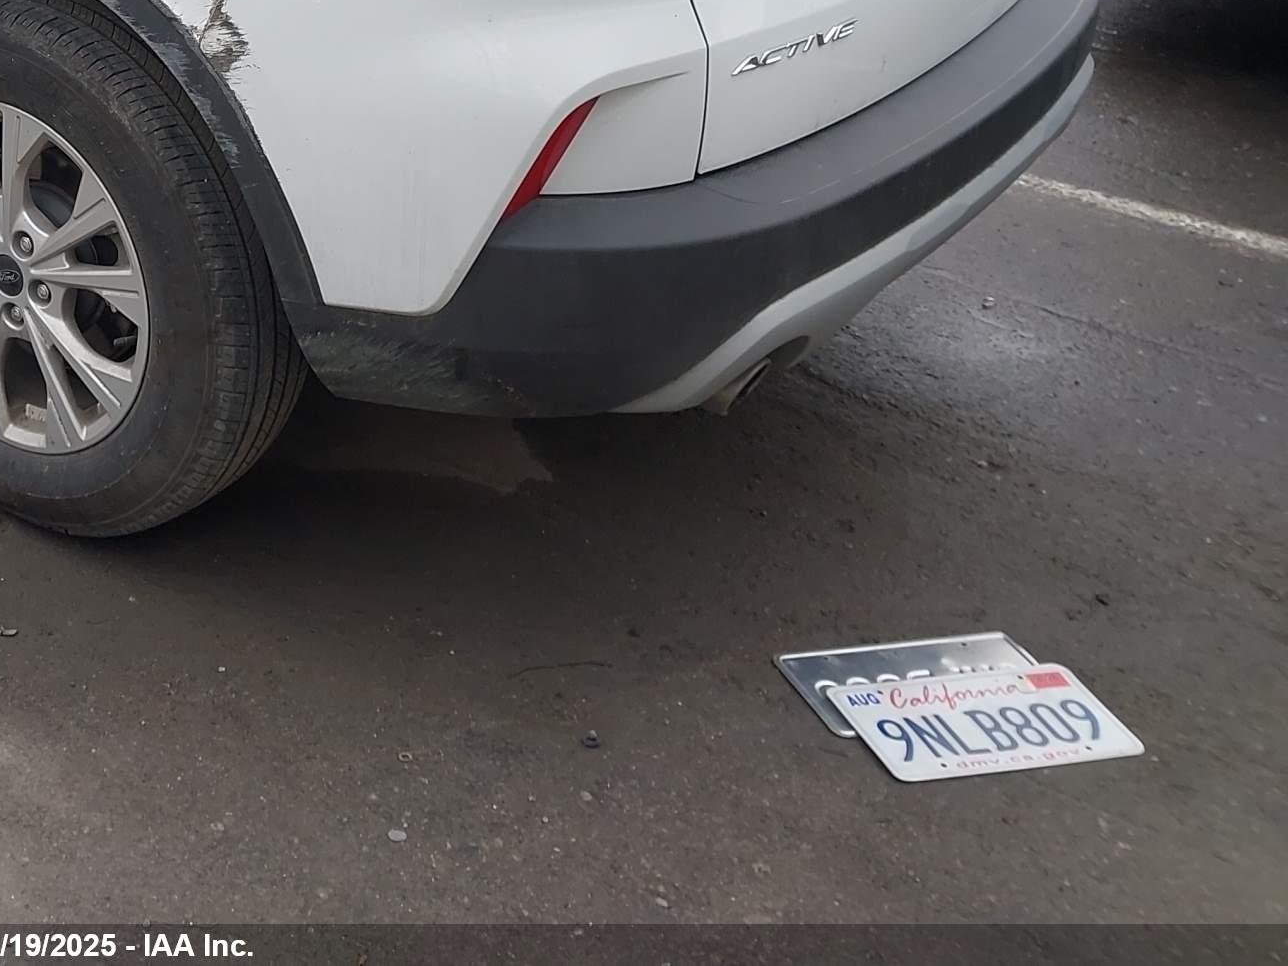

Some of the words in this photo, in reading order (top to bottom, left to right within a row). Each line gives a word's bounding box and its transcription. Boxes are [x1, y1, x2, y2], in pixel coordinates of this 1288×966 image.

[730, 17, 859, 77] ACTIVE
[847, 692, 881, 707] AUG
[889, 682, 1021, 711] California
[876, 699, 1100, 763] 9NLB809
